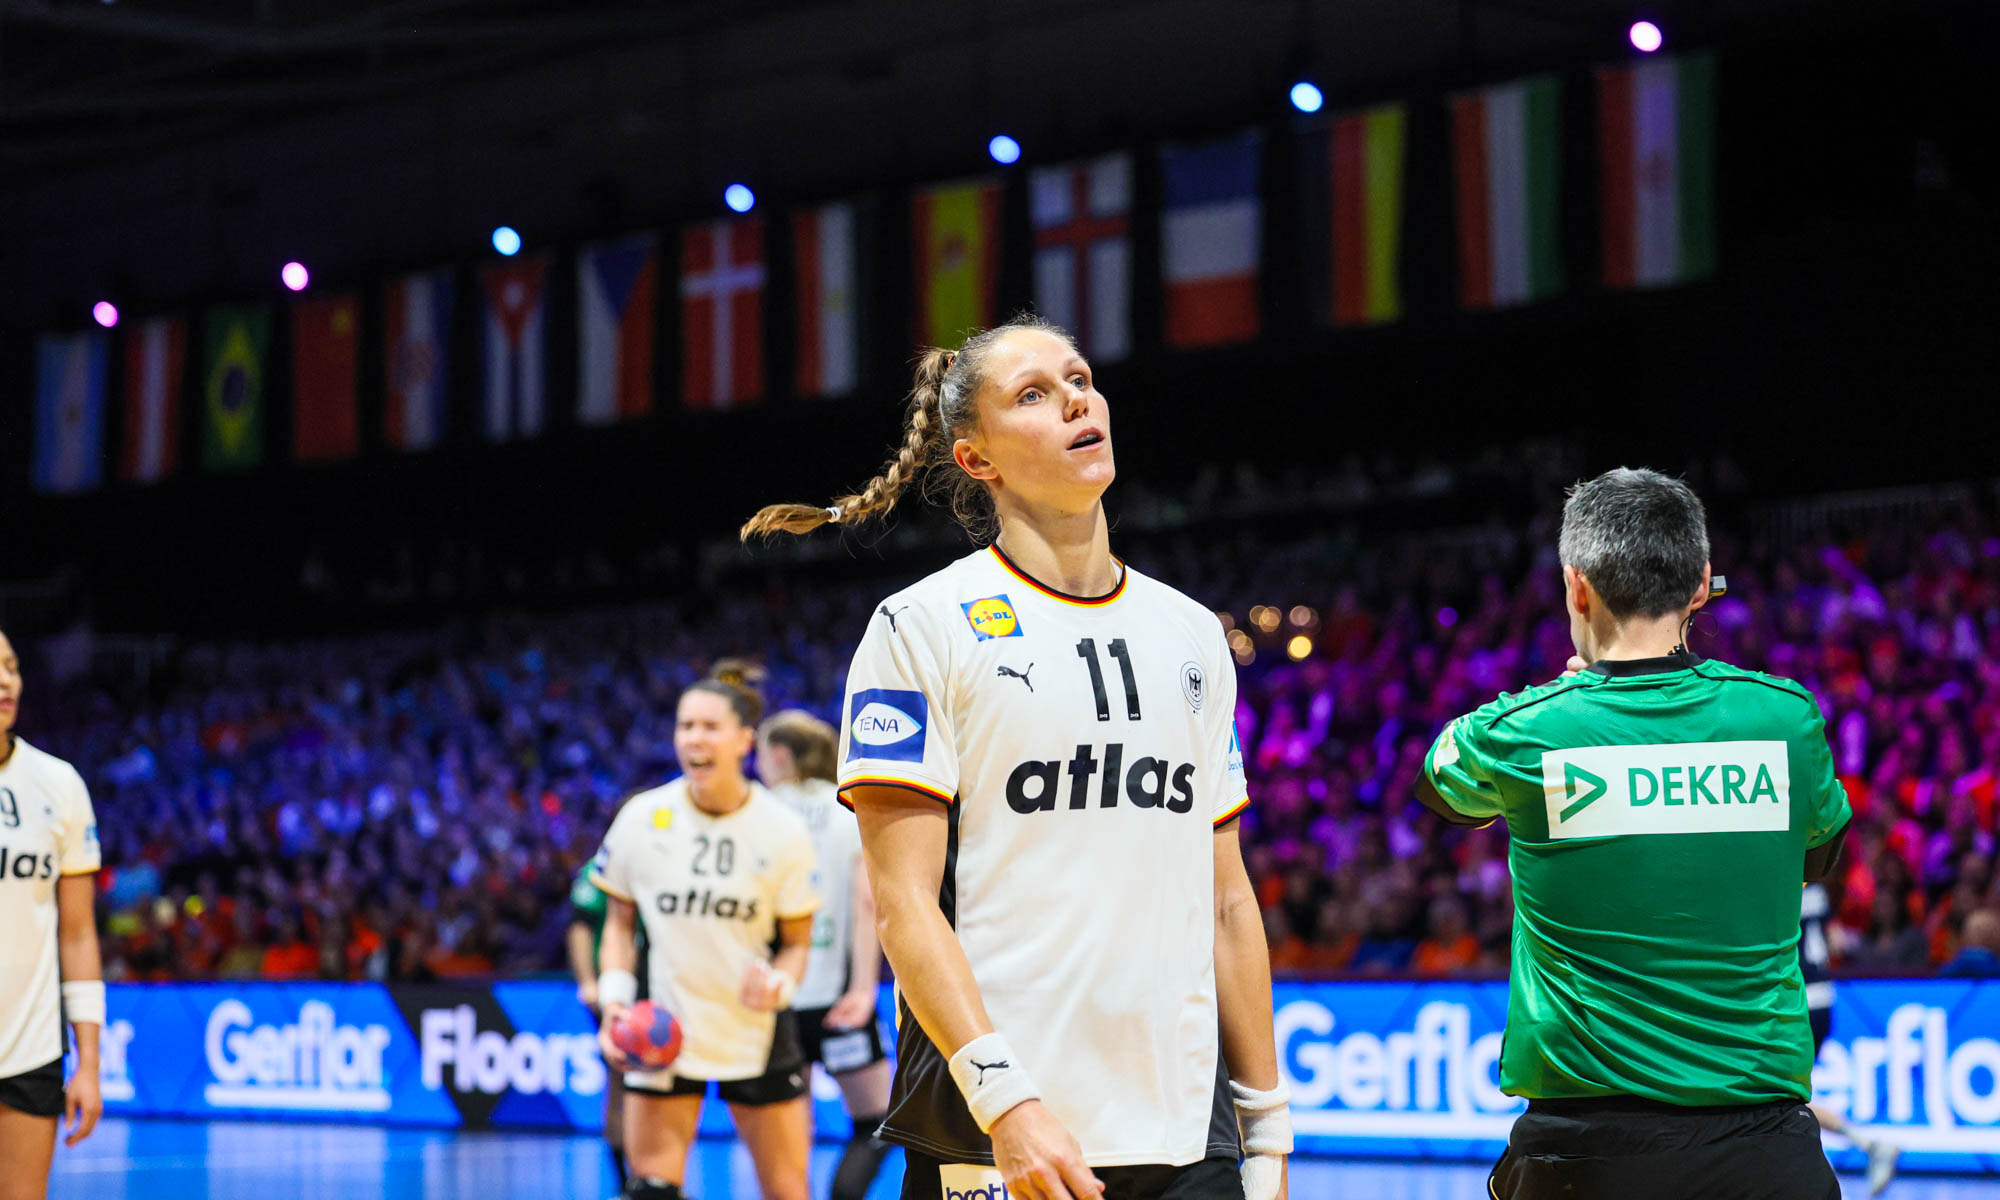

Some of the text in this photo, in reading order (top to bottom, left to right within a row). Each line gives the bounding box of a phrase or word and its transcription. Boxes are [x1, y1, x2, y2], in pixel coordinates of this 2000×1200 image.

[974, 611, 1012, 625] LIDL
[1076, 638, 1142, 721] 11
[860, 716, 898, 733] TENA
[1005, 743, 1196, 815] atlas
[1628, 763, 1779, 807] DEKRA
[0, 848, 52, 879] las
[691, 835, 735, 876] 20
[656, 888, 757, 921] atlas
[205, 999, 391, 1091] Gerflor
[421, 1004, 603, 1095] Floors
[1274, 1000, 1521, 1114] Gerflo
[1811, 1002, 2000, 1130] erflo
